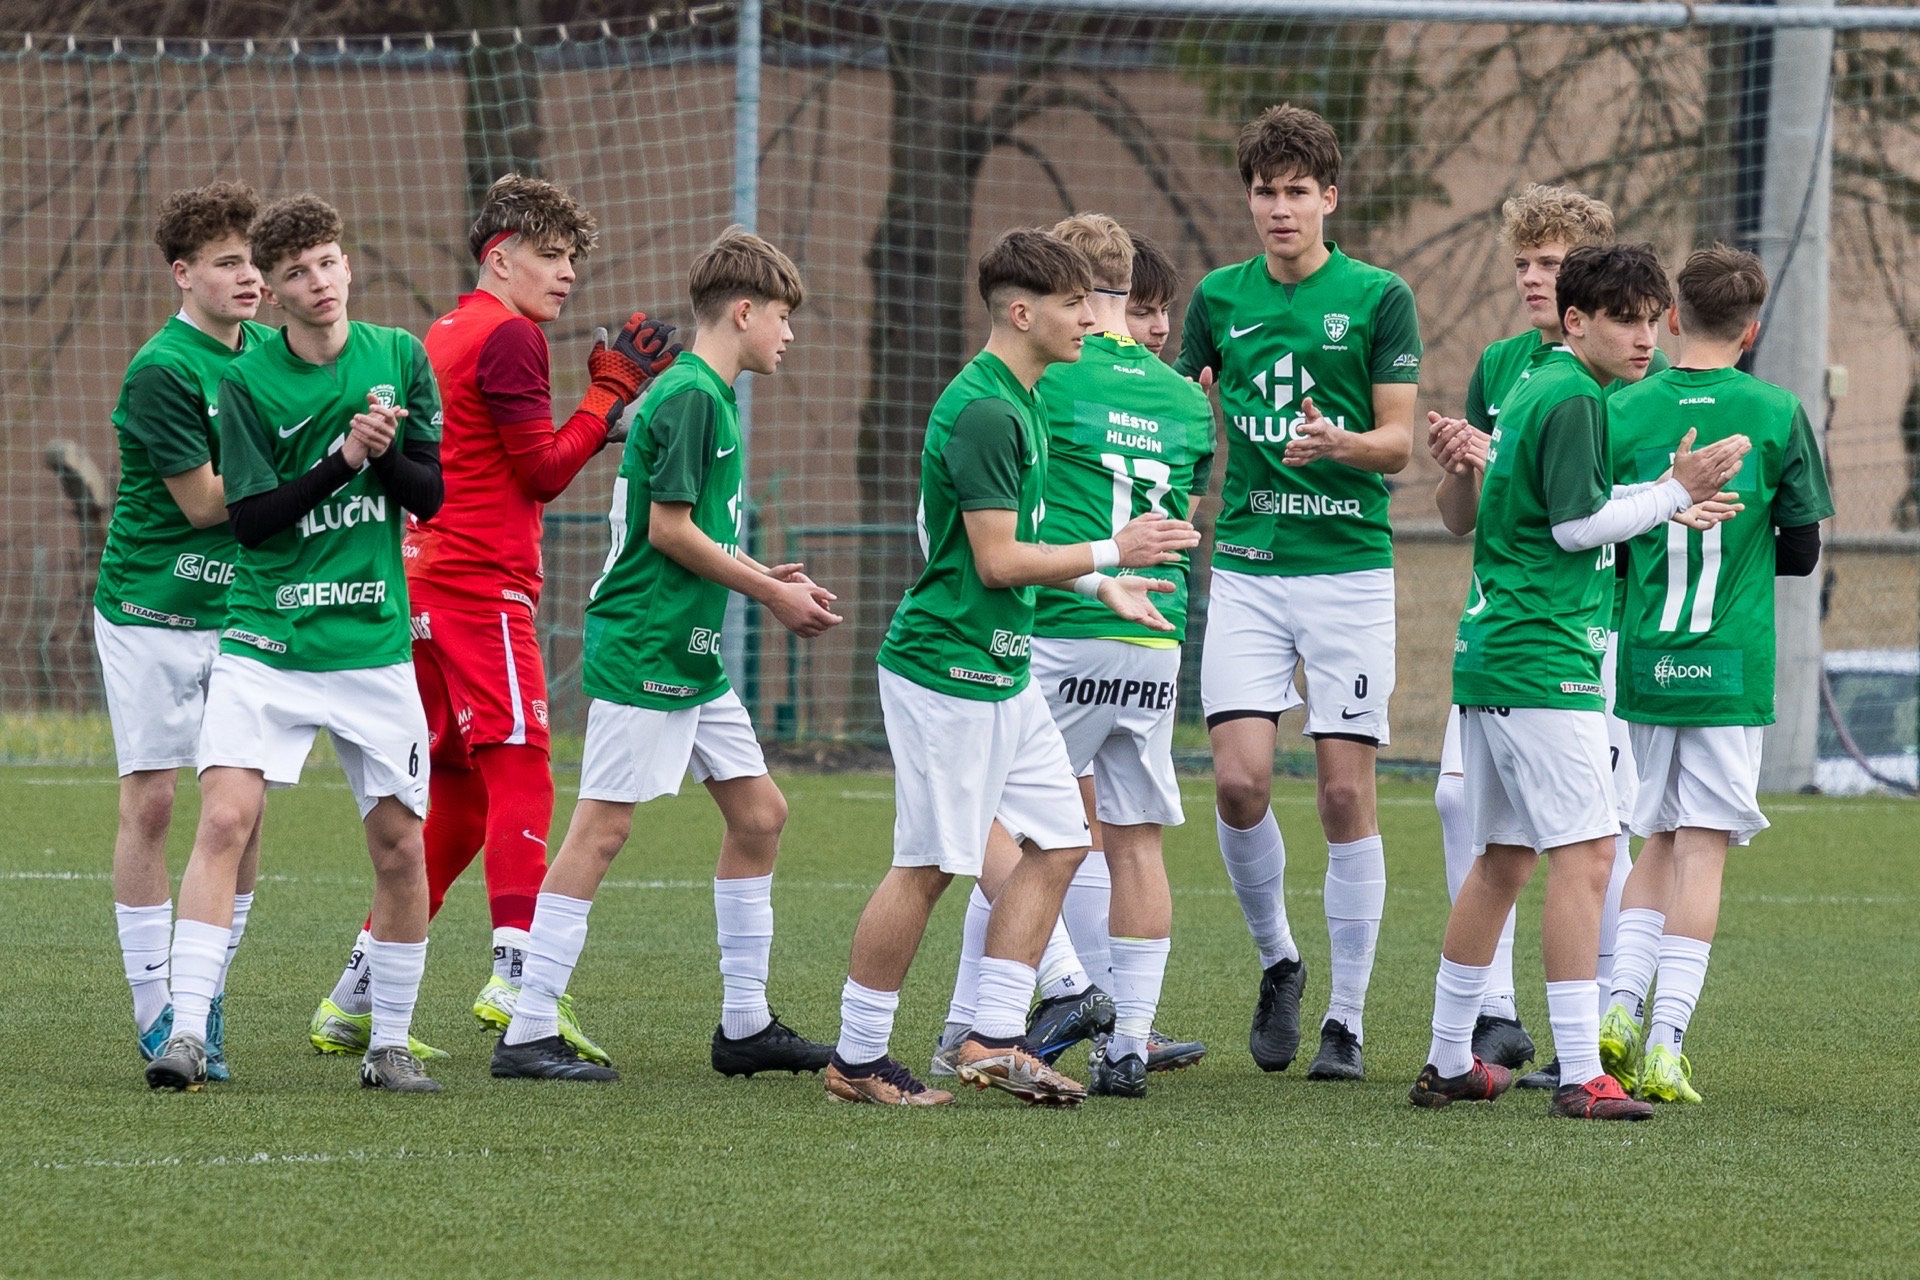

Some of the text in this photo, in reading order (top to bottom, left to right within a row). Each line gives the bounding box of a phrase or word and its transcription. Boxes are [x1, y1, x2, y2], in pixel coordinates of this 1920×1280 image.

[1108, 411, 1158, 433] MĚSTO
[1106, 430, 1162, 453] HLUČÍN
[1274, 493, 1363, 518] GIENGER
[297, 581, 386, 607] GIENGER
[1654, 665, 1712, 679] SEADON
